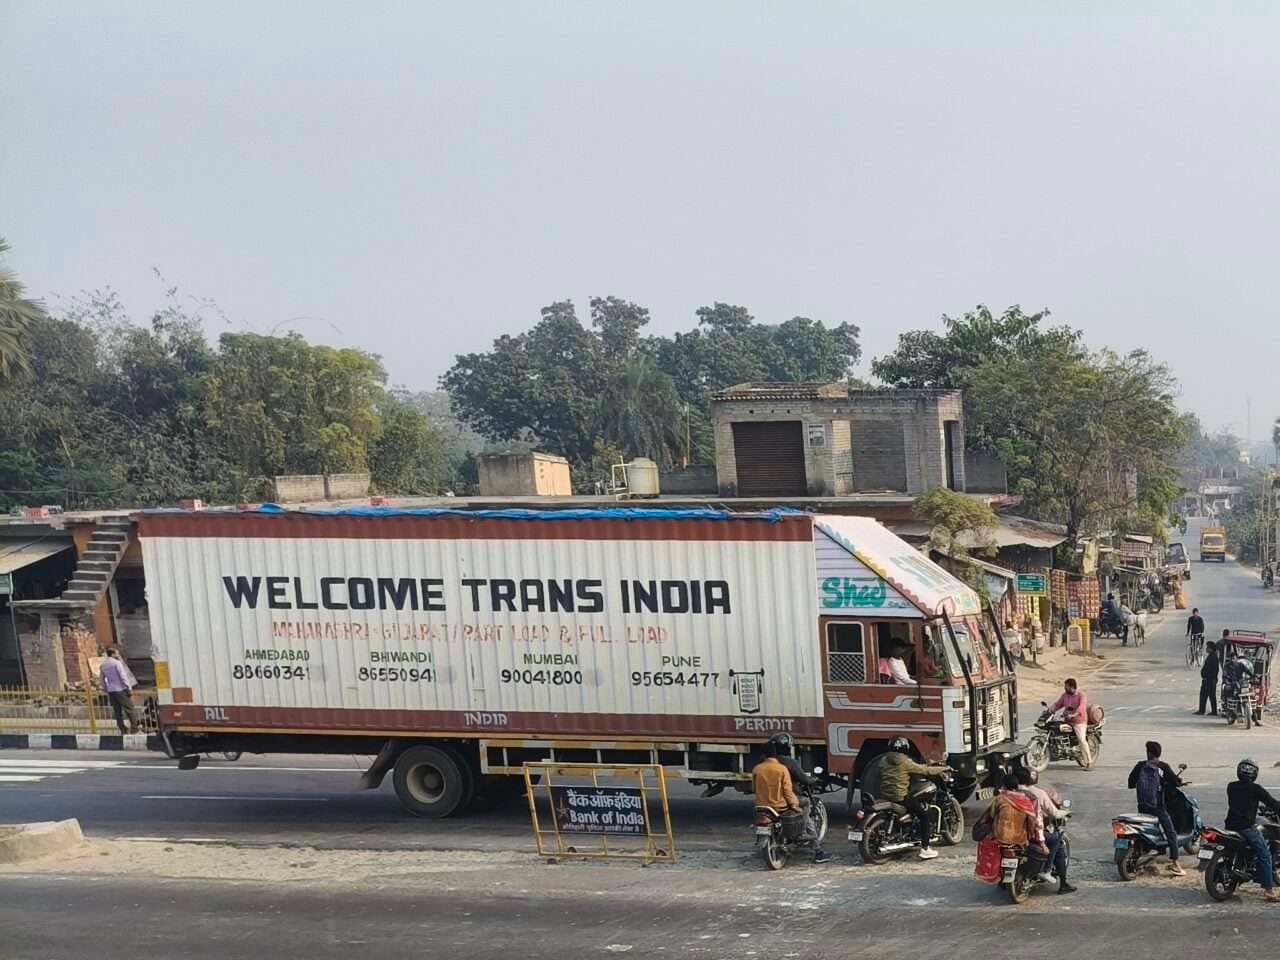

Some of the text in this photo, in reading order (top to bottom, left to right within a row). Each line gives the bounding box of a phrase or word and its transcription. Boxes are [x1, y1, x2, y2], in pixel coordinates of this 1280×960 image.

[222, 576, 731, 614] WELCOME TRANS INDIA
[245, 649, 310, 662] AHMEDABAD
[370, 651, 432, 663] BHIWANDI
[523, 653, 578, 665] MUMBAI
[662, 656, 701, 667] PUNE
[632, 671, 719, 687] 95654477
[204, 707, 230, 720] ALL
[464, 711, 508, 726] INDIA
[569, 809, 645, 825] Bank of India
